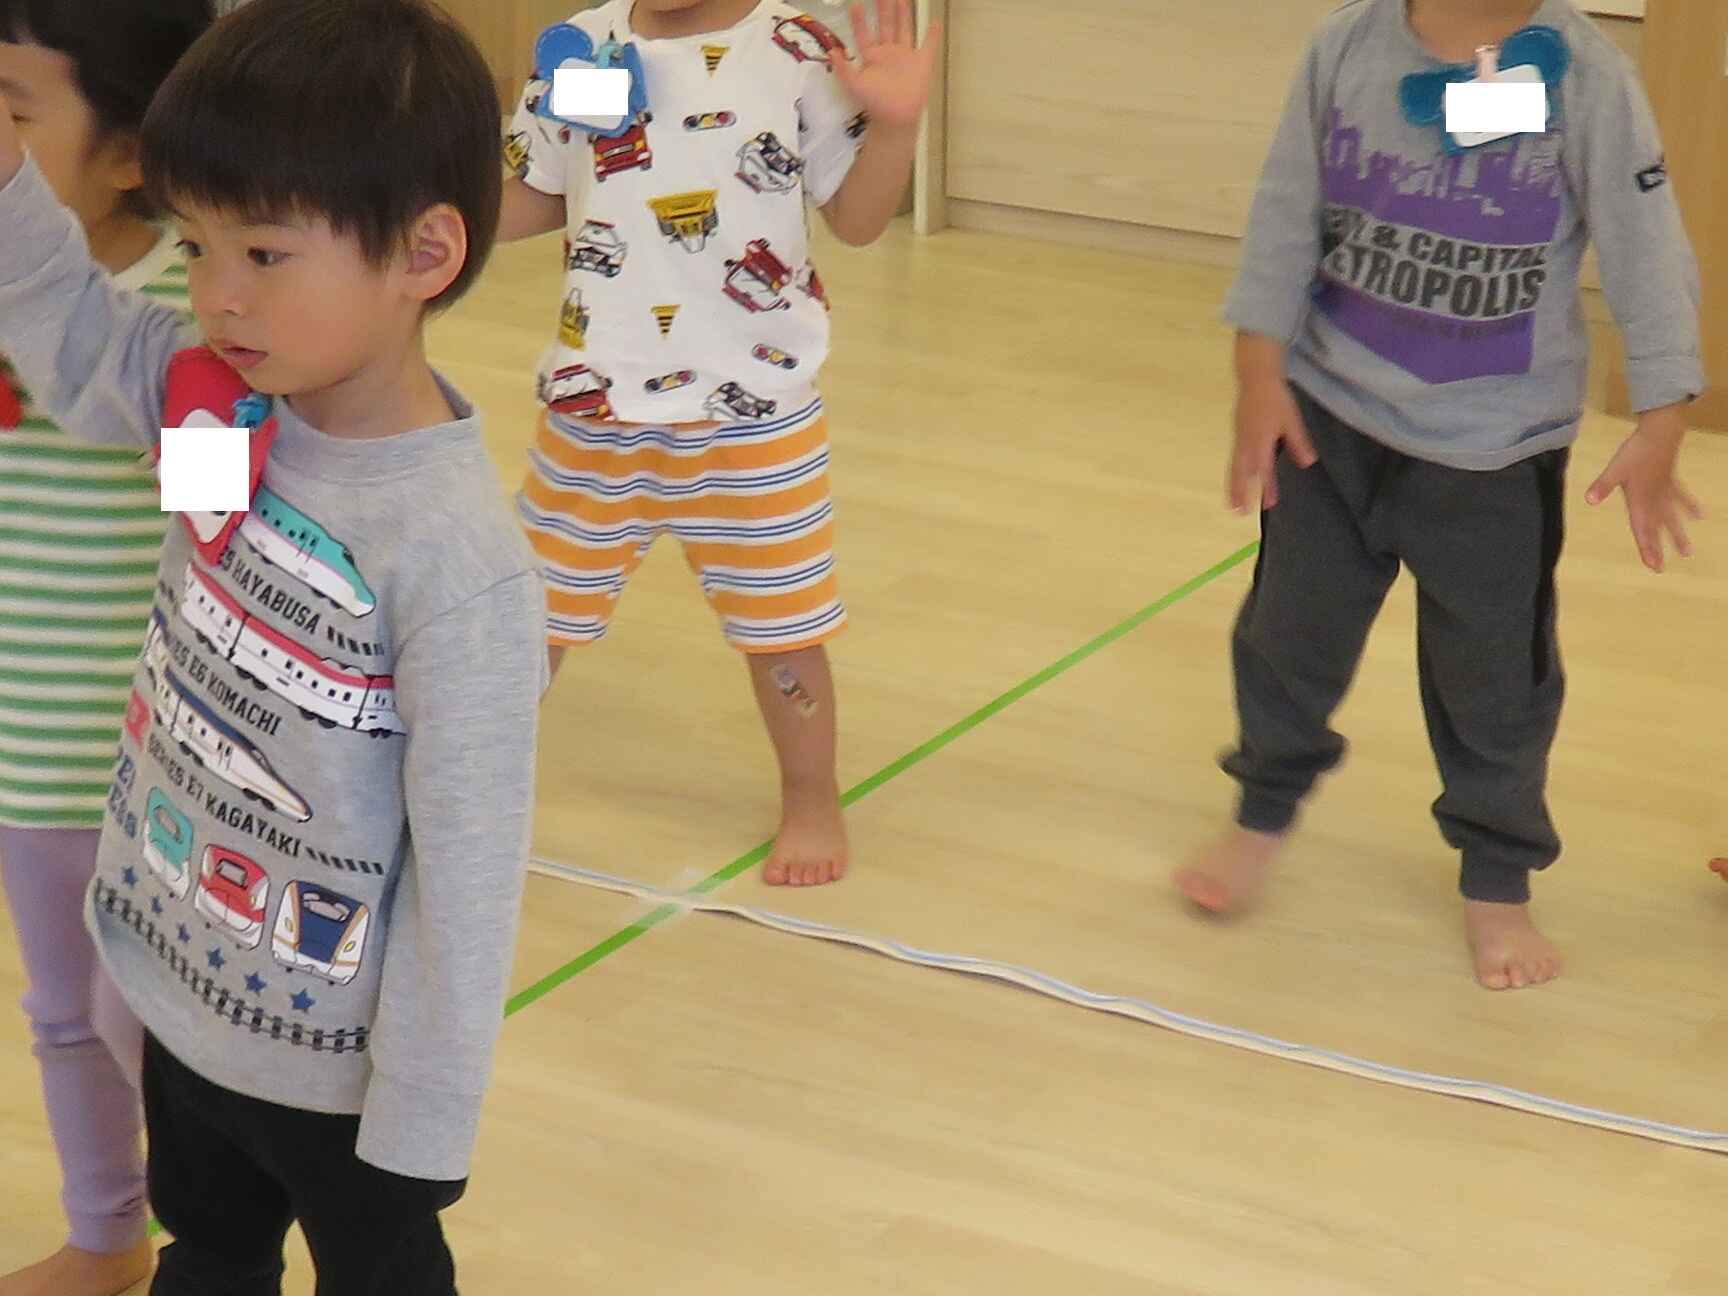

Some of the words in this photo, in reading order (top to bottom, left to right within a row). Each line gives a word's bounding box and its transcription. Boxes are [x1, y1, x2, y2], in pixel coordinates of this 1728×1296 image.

[232, 560, 322, 636] HAYABUSA
[207, 671, 283, 737] KOMACHI
[204, 791, 302, 860] KAGAYAKI
